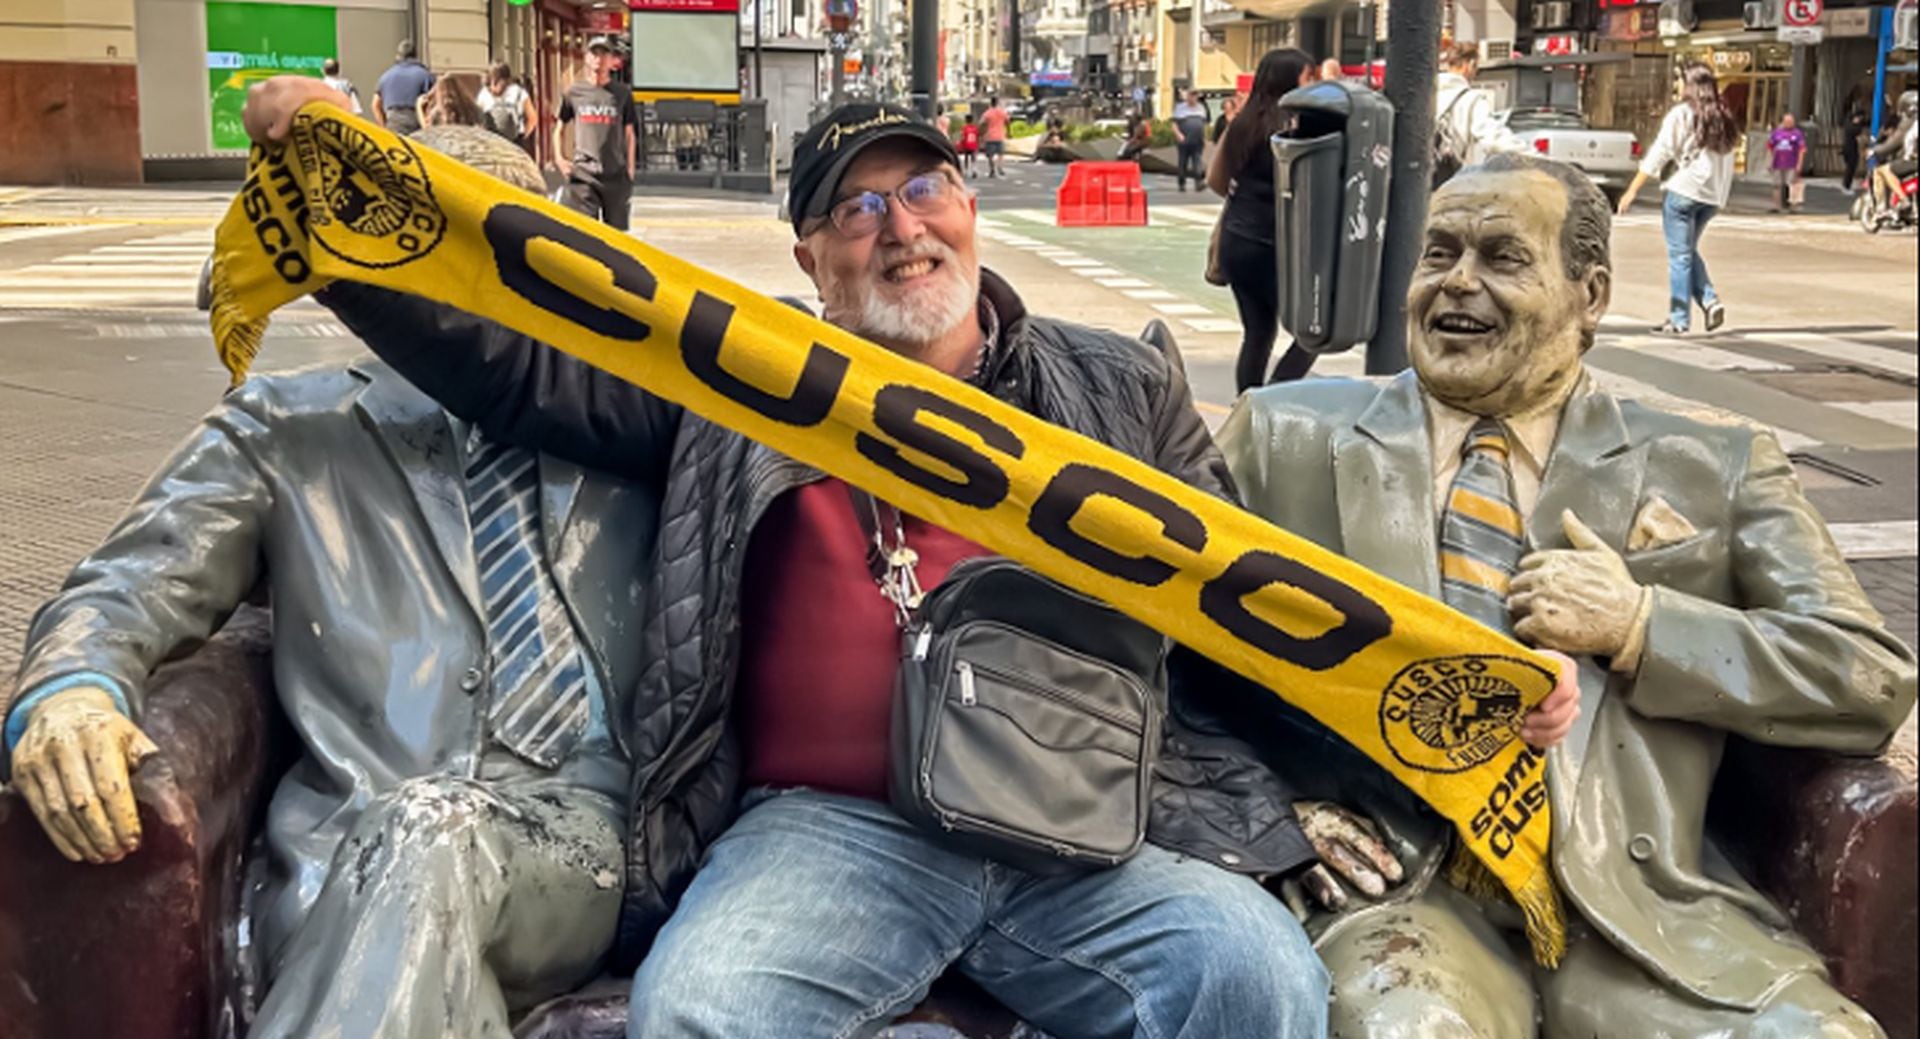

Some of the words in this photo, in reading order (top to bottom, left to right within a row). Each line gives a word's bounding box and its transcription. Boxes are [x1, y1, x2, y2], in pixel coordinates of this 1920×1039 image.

[816, 107, 909, 151] Fender
[484, 202, 1394, 672] CUSCO
[1386, 658, 1488, 722] CUSCO
